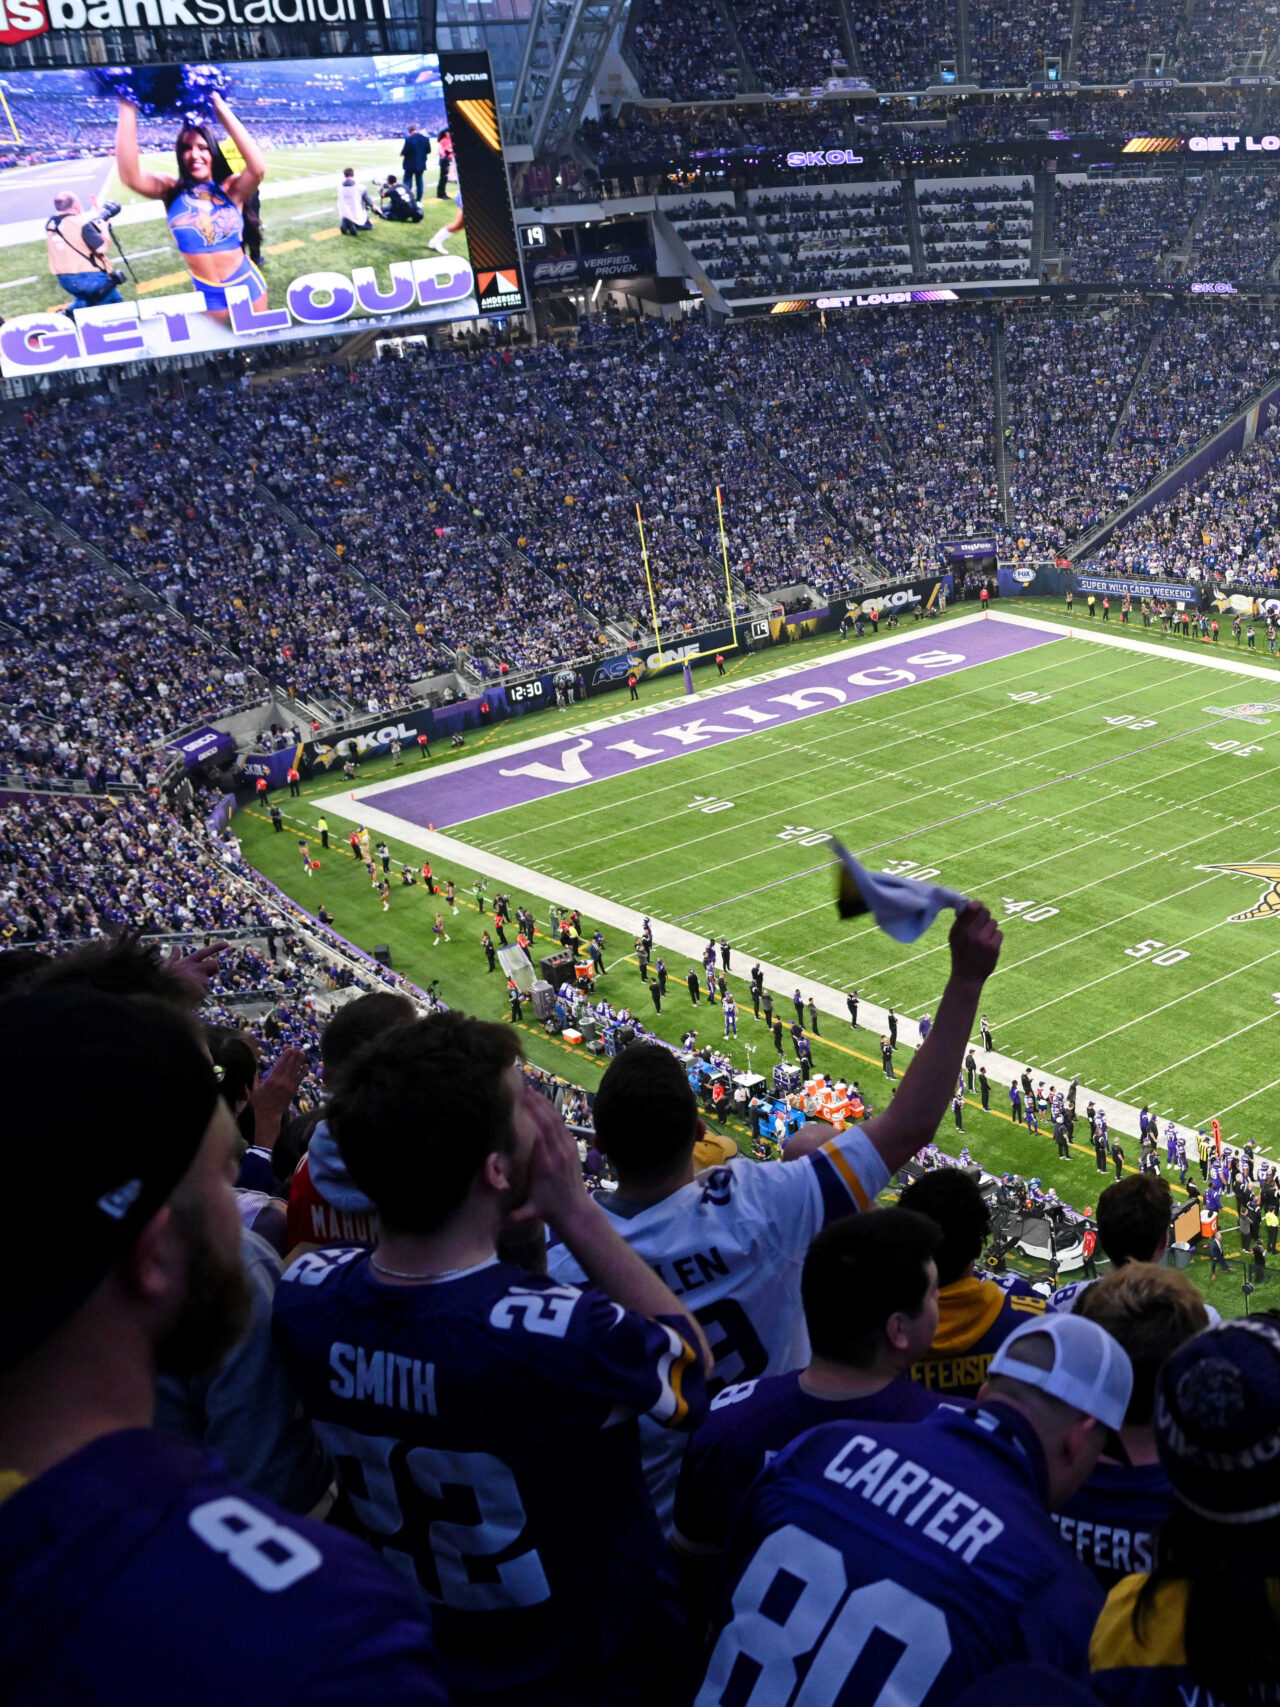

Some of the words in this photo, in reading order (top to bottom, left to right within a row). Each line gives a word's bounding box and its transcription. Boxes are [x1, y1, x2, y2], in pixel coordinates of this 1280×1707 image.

[454, 73, 488, 82] PENTAIR
[1188, 137, 1240, 151] GET
[787, 150, 863, 167] SKOL
[527, 226, 544, 246] 19
[534, 260, 578, 278] FVP
[584, 255, 632, 268] VERIFIED.
[594, 263, 639, 276] PROVEN.
[1191, 282, 1238, 294] SKOL
[481, 293, 521, 306] ANDERSEN
[816, 296, 853, 309] GET
[856, 291, 912, 307] LOUD!
[0, 291, 207, 377] GET
[225, 255, 474, 336] LOUD
[1081, 579, 1105, 590] SUPER
[1108, 582, 1127, 592] WILD
[1129, 584, 1152, 595] CARD
[1154, 586, 1191, 599] WEEKEND
[862, 588, 921, 614] SKOL
[755, 624, 767, 634] 19
[647, 642, 700, 669] ONE
[511, 681, 543, 701] 12:30
[563, 725, 590, 736] IT
[602, 698, 687, 725] TAKES
[694, 682, 747, 699] ALL
[749, 670, 782, 686] OF
[785, 659, 822, 674] US
[183, 733, 218, 752] GEICO
[336, 723, 418, 756] SKOL
[198, 747, 218, 761] GEICO
[244, 763, 265, 776] SKOL
[687, 796, 735, 814] 10
[775, 826, 834, 847] 20
[882, 860, 942, 882] 30
[1003, 900, 1061, 923] 40
[1123, 939, 1192, 967] 50
[311, 1204, 380, 1244] MAHOM
[329, 1340, 438, 1416] SMITH
[709, 1378, 760, 1411] 8
[824, 1434, 1005, 1564] CARTER
[311, 1418, 552, 1611] 22
[187, 1495, 324, 1593] 8
[693, 1524, 952, 1707] 80
